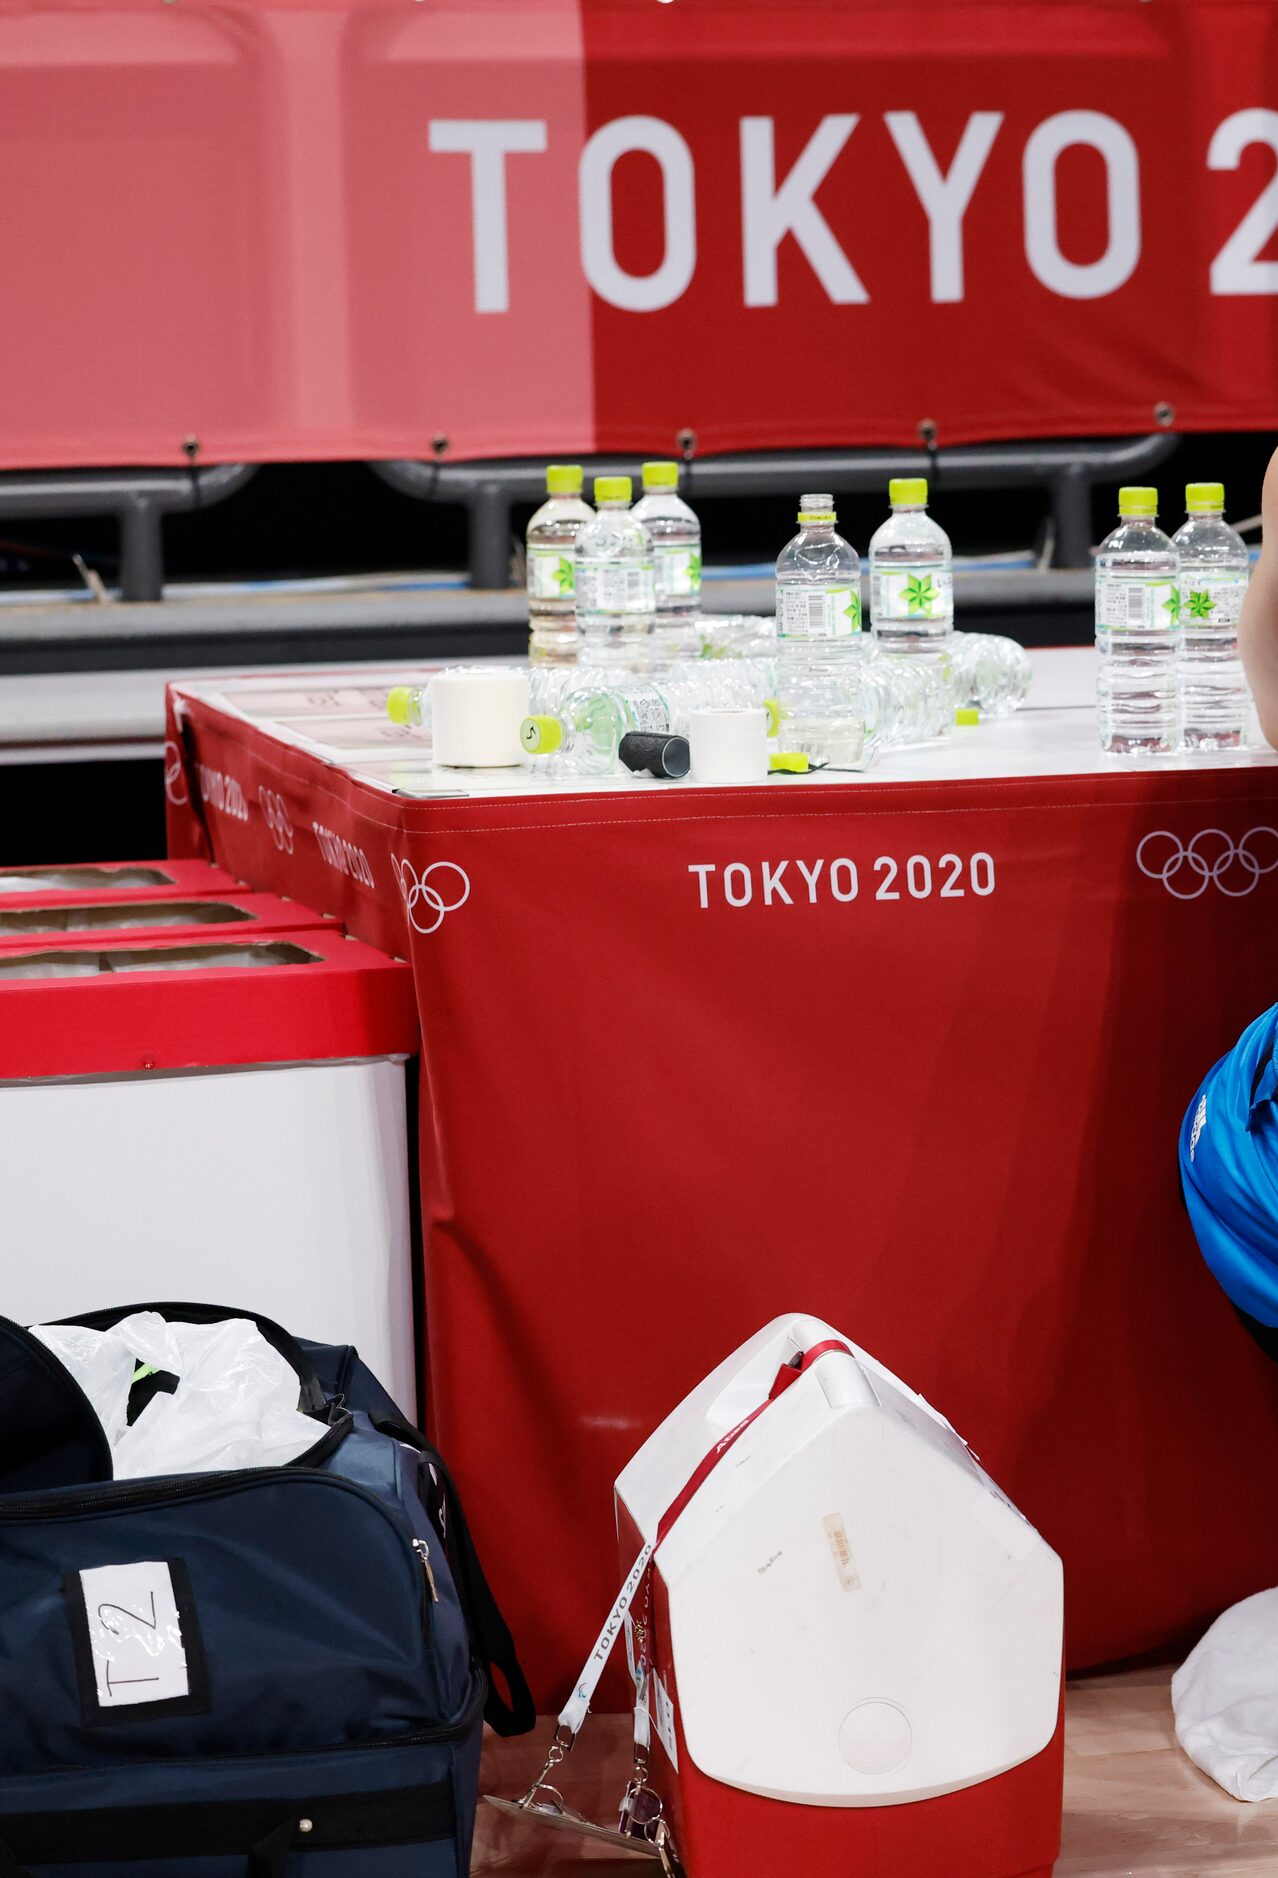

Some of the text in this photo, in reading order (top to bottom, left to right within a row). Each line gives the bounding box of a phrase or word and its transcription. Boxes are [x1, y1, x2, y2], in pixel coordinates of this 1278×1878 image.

[429, 109, 1141, 314] TOKYO
[687, 851, 996, 908] TOKYO 2020
[593, 1596, 629, 1662] TOKYO
[625, 1544, 652, 1595] 2020
